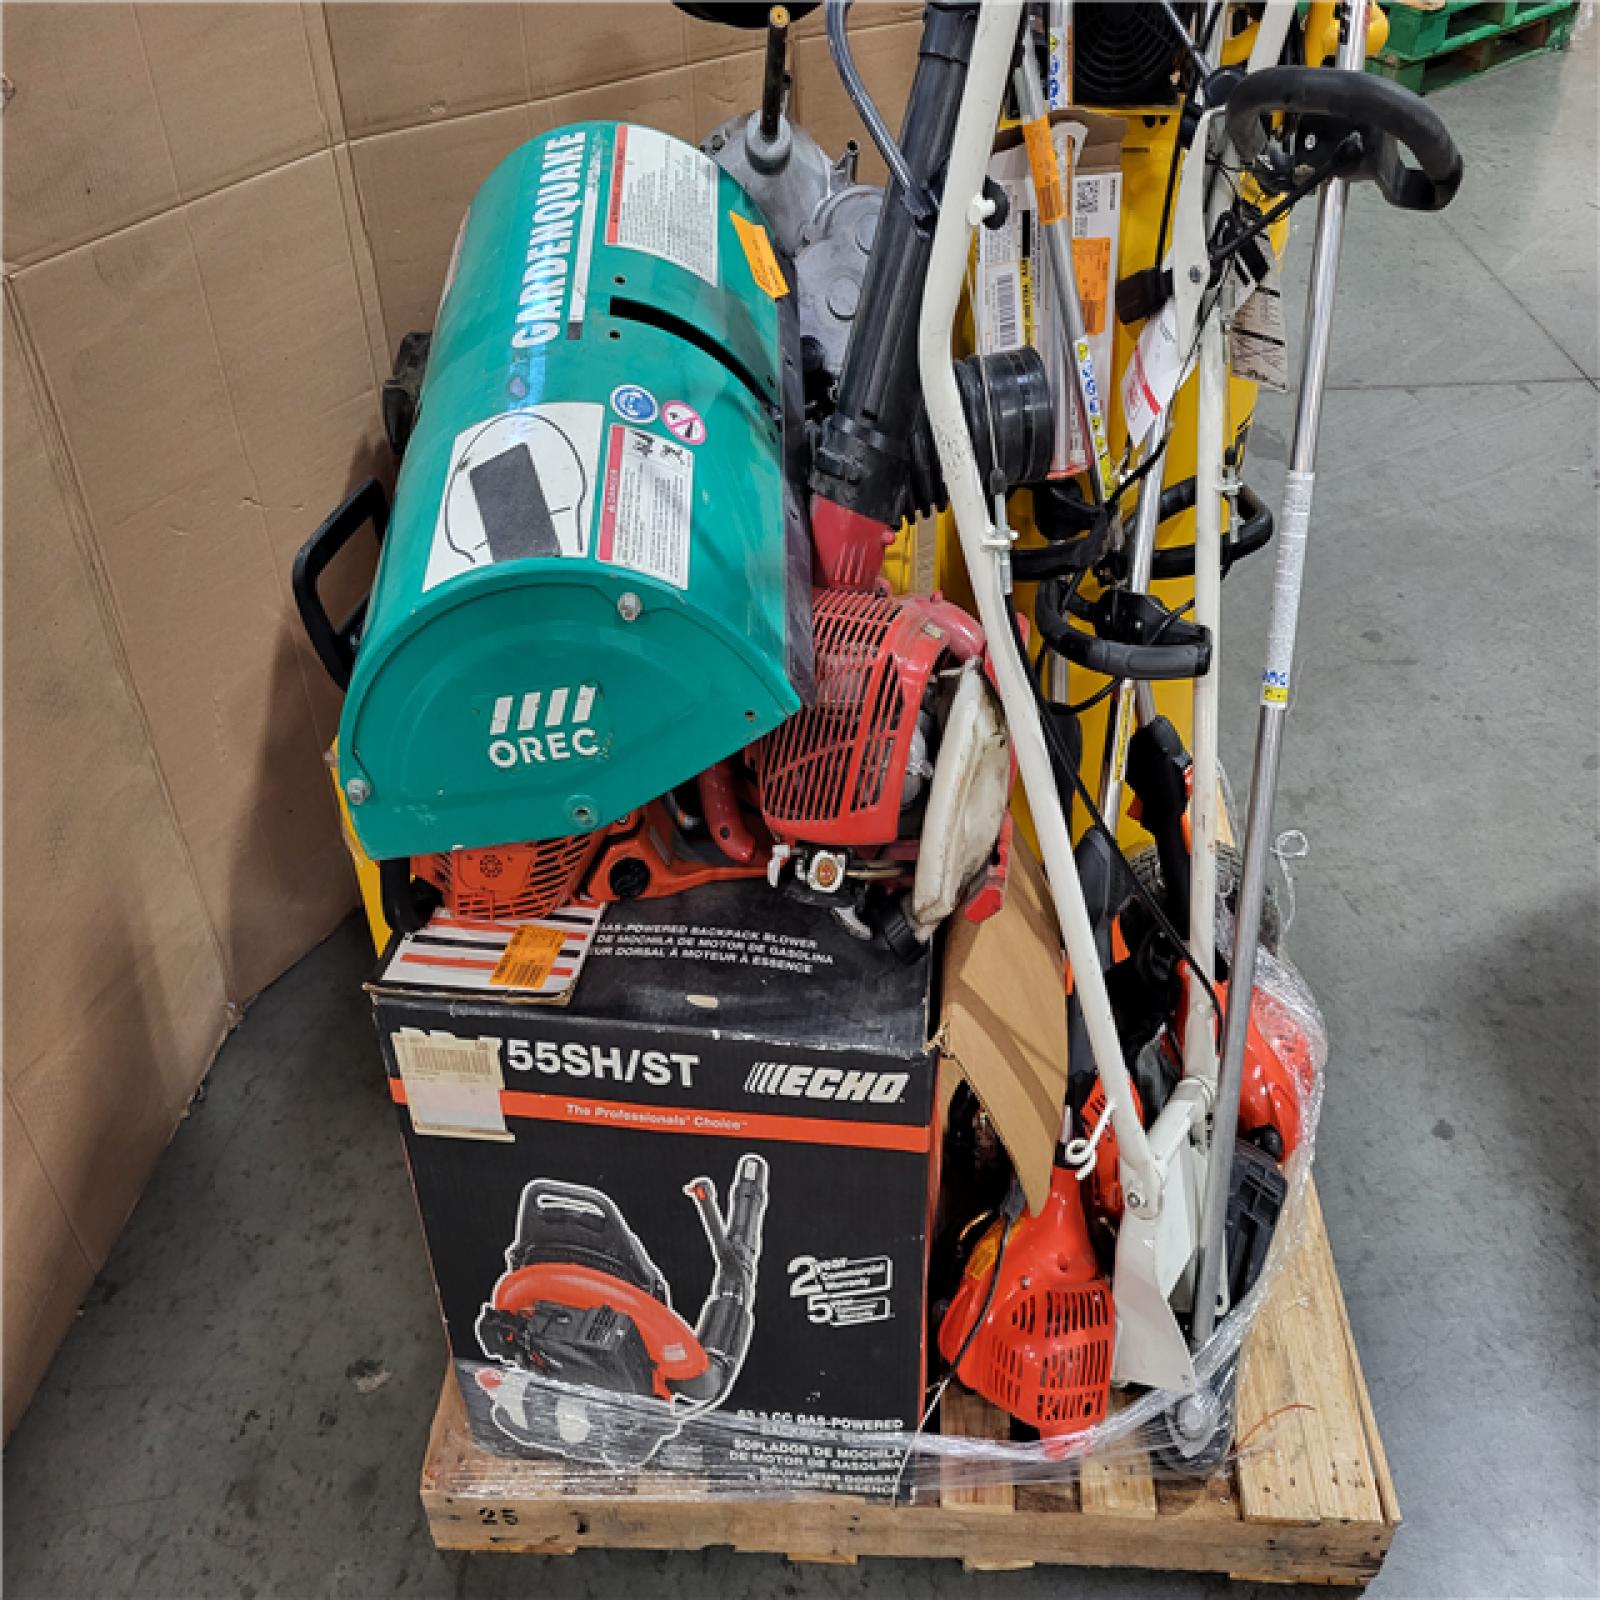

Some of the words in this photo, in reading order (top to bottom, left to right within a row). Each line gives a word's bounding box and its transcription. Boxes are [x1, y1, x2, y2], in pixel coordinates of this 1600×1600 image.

[512, 132, 586, 348] GARDENQUAKE
[489, 727, 598, 768] OREC
[779, 1063, 910, 1103] ECHO
[566, 1103, 591, 1116] The
